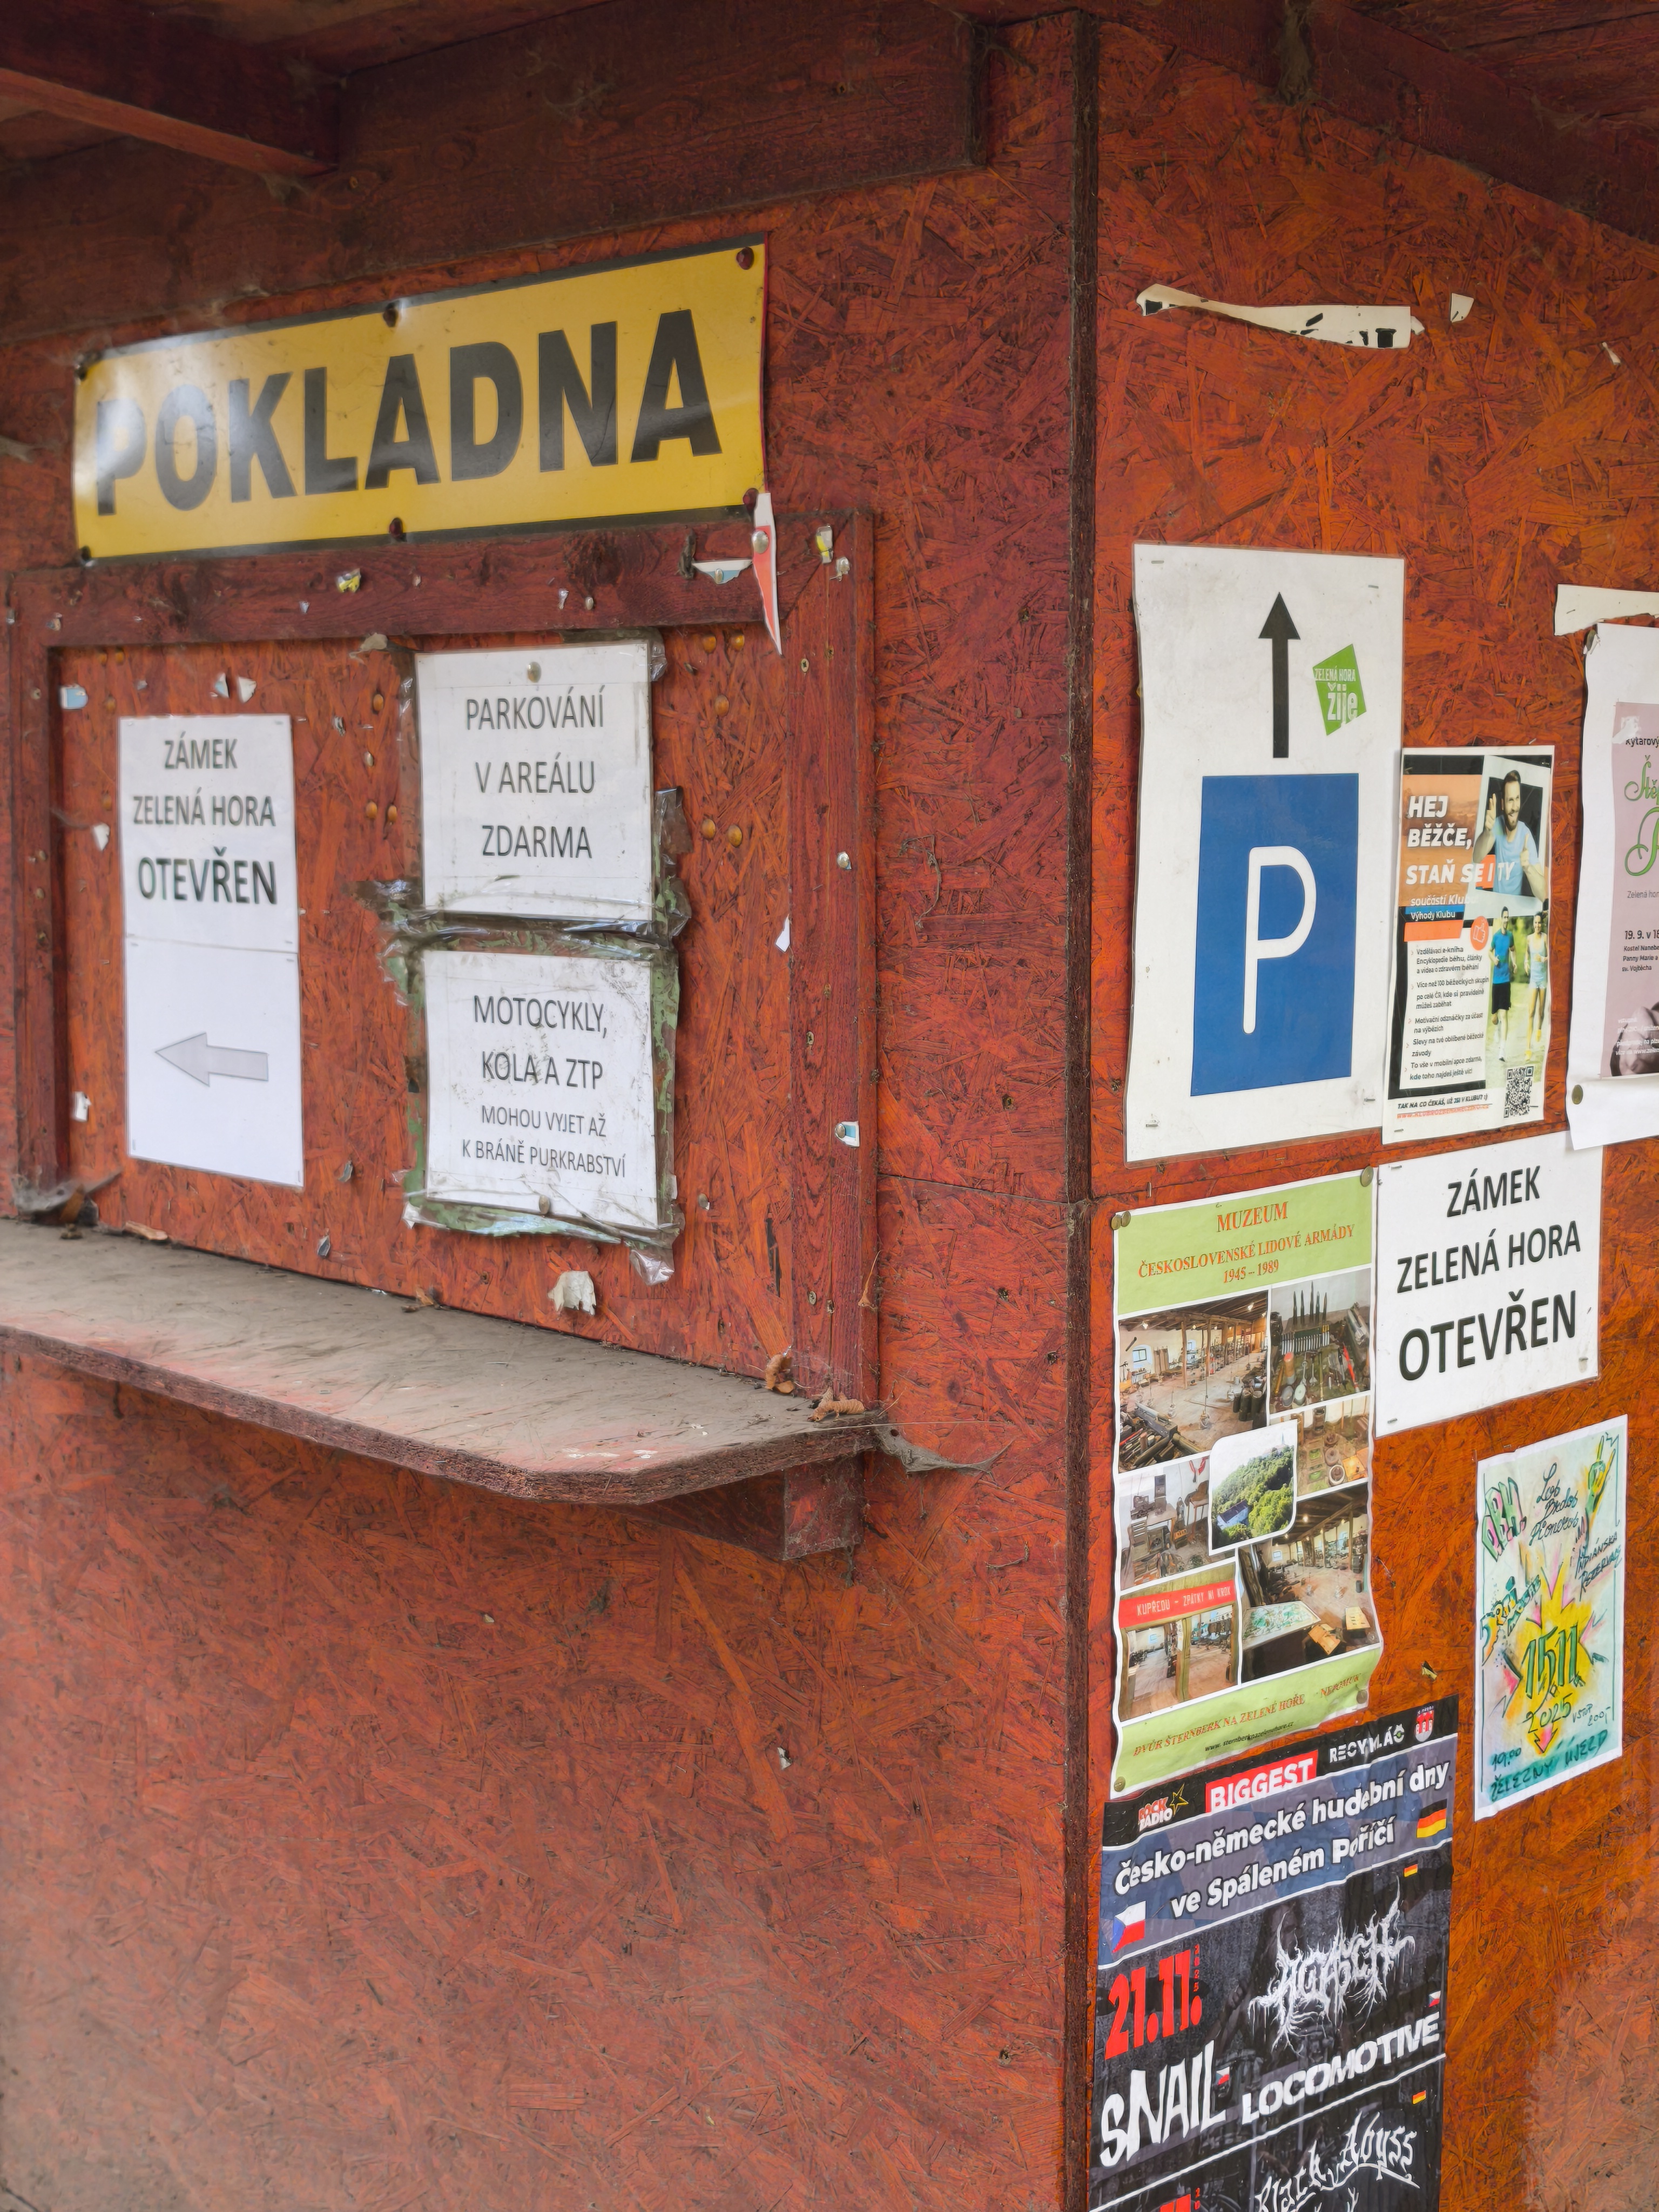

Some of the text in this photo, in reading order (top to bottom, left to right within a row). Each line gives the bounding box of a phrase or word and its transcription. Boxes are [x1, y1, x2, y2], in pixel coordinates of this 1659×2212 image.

[97, 308, 722, 516] POKLADNA
[1315, 665, 1356, 682] ZELENÁ HORA
[466, 685, 605, 730] PARKOVÁNÍ
[165, 731, 238, 769] ZÁMEK
[475, 752, 595, 794] V AREÁLU
[133, 787, 276, 827] ZELENÁ HORA
[1408, 795, 1448, 818] HEJ
[482, 825, 592, 859] ZDARMA
[1407, 823, 1472, 850] BĚŽČE,
[138, 846, 277, 905] OTEVŘEN
[1406, 859, 1515, 885] STAŇ SE I TY
[1411, 894, 1447, 906] součástí
[1411, 911, 1455, 921] Výhody Klubu
[1243, 846, 1316, 1034] P
[1625, 930, 1635, 940] 19.
[1637, 930, 1644, 939] 9.
[1417, 956, 1448, 965] Encyklopedie
[474, 995, 607, 1038] MOTOCYKLY,
[482, 1051, 603, 1090] KOLA A ZTP
[482, 1105, 606, 1137] MOHOU VYJET AŽ
[462, 1138, 626, 1178] K BRÁNĚ PURKRABSTVÍ
[1447, 1165, 1541, 1218] ZÁMEK
[1217, 1201, 1289, 1233] MUZEUM
[1138, 1223, 1355, 1278] ČESKOSLOVENSKÉ LIDOVÉ ARMÁDY
[1223, 1266, 1246, 1284] 1945
[1257, 1259, 1279, 1276] 1989
[1397, 1220, 1581, 1293] ZELENÁ HORA
[1399, 1289, 1576, 1381] OTEVŘEN
[1137, 1599, 1170, 1616] KUPŘEDU
[1183, 1592, 1204, 1606] ZPÁTKY
[1208, 1589, 1214, 1600] NI
[1217, 1586, 1231, 1597] KROK
[1133, 1737, 1163, 1757] DVŮR
[1165, 1719, 1222, 1750] ŠTERNBERK
[1223, 1715, 1238, 1727] NA
[1239, 1702, 1278, 1724] ZELENÉ
[1522, 1692, 1573, 1734] 2025
[1210, 1758, 1314, 1812] BIGGEST
[1114, 1761, 1450, 1896] Česko-německé hudební dny
[1170, 1815, 1395, 1919] ve Spáleném Poříčí
[1105, 1949, 1202, 2060] 21.11.
[1242, 2011, 1440, 2125] LOCOMOTIVE
[1100, 2040, 1226, 2168] SNAIL
